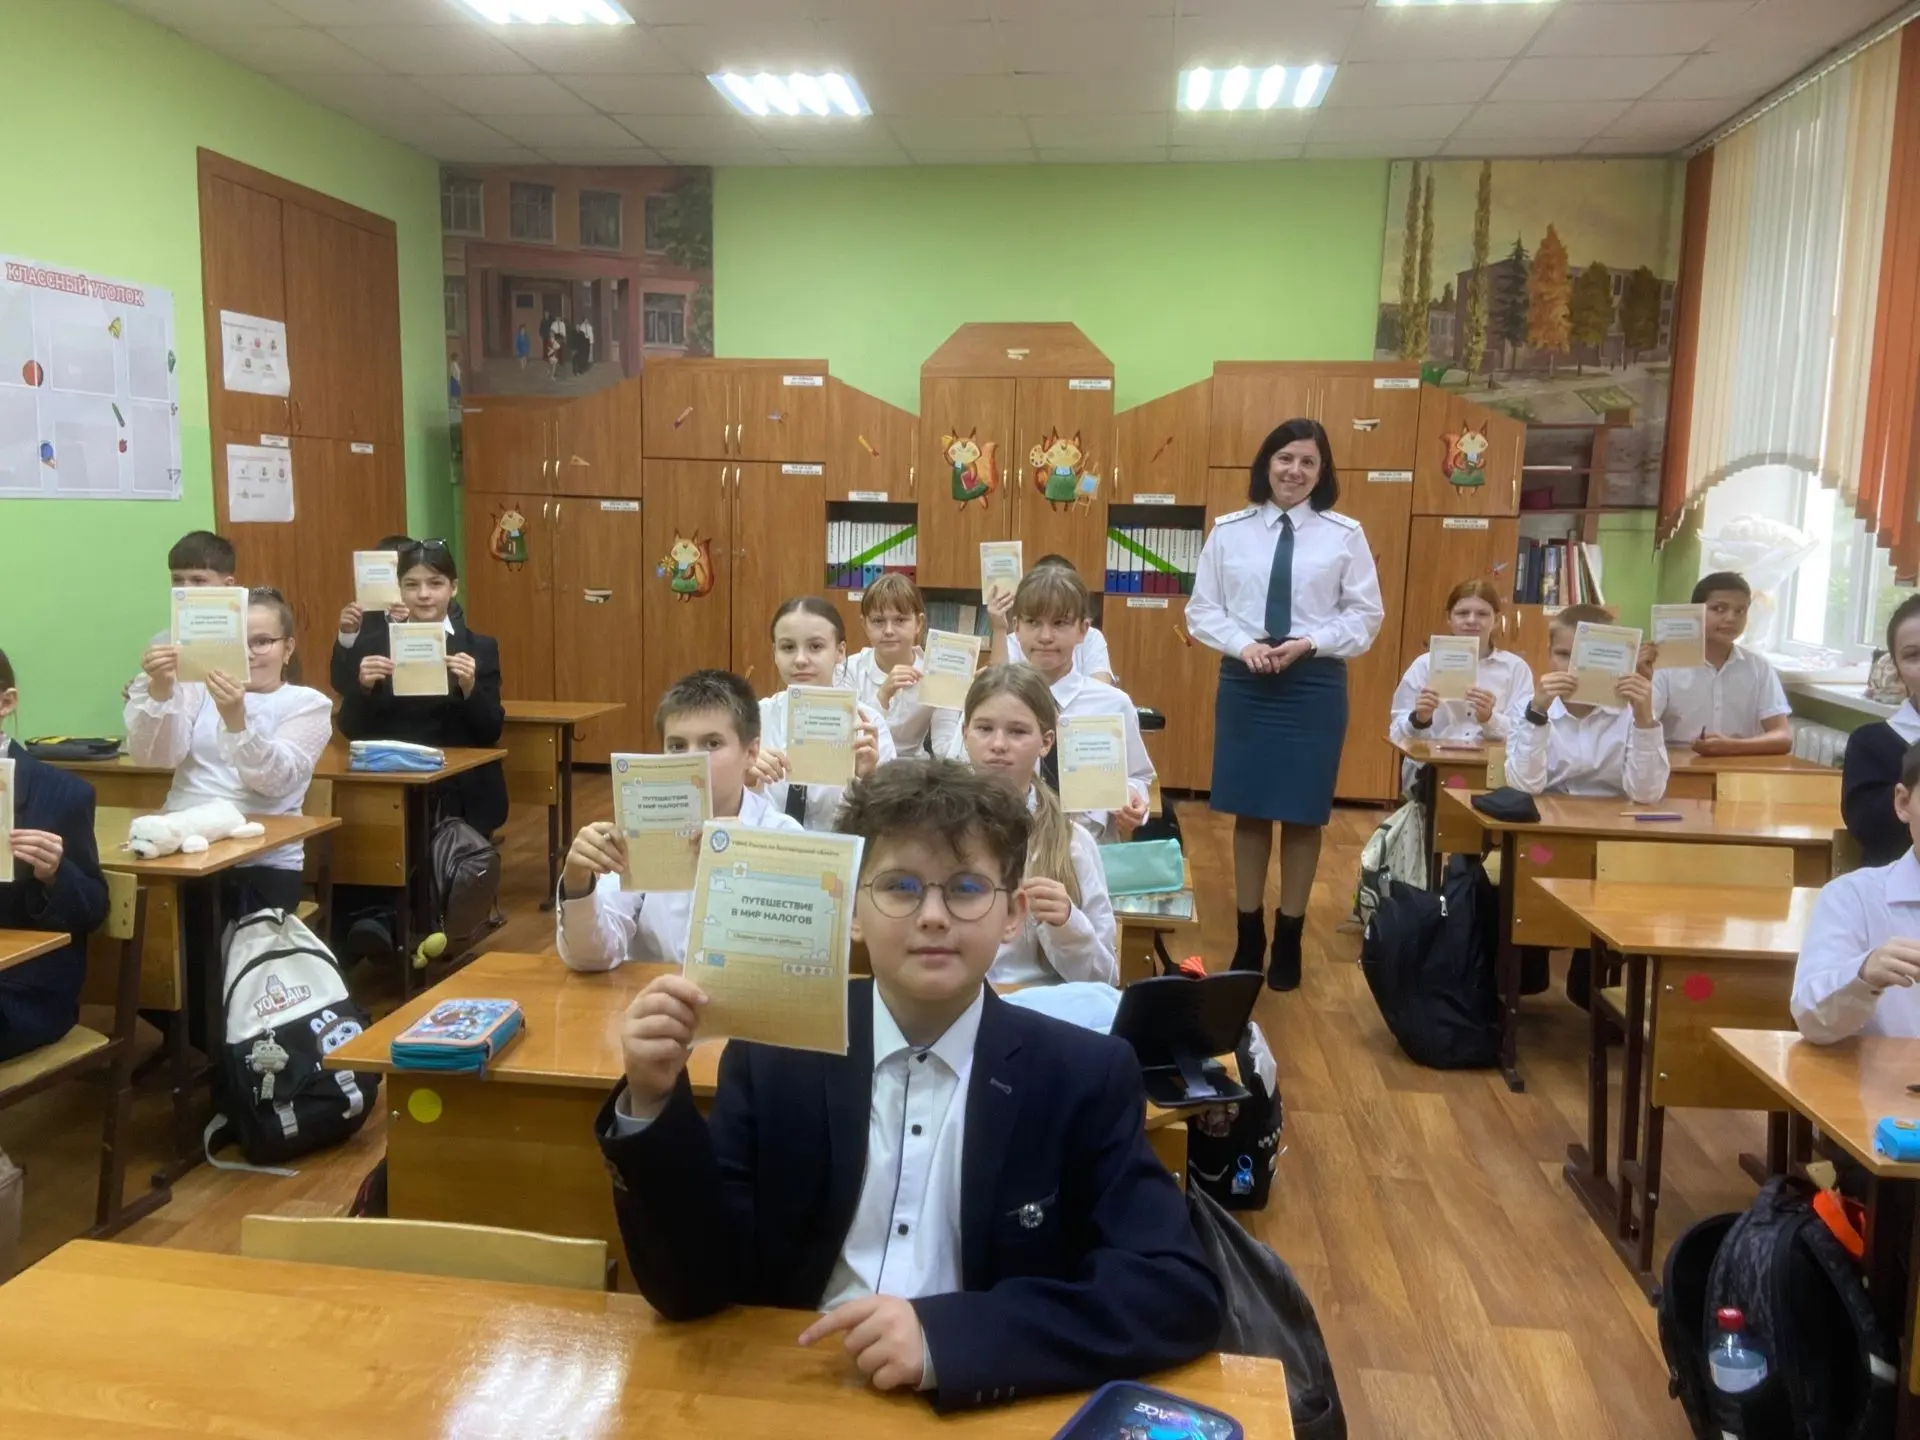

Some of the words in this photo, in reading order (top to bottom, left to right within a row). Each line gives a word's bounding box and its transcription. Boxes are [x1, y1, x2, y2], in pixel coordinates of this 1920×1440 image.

[6, 262, 89, 297] КЛАССНЫЙ
[90, 279, 145, 307] УГОЛОК
[741, 895, 814, 912] ПУТЕШЕСТВИЕ
[731, 908, 738, 916] В
[740, 908, 762, 919] МИР
[763, 911, 813, 925] НАЛОГОВ
